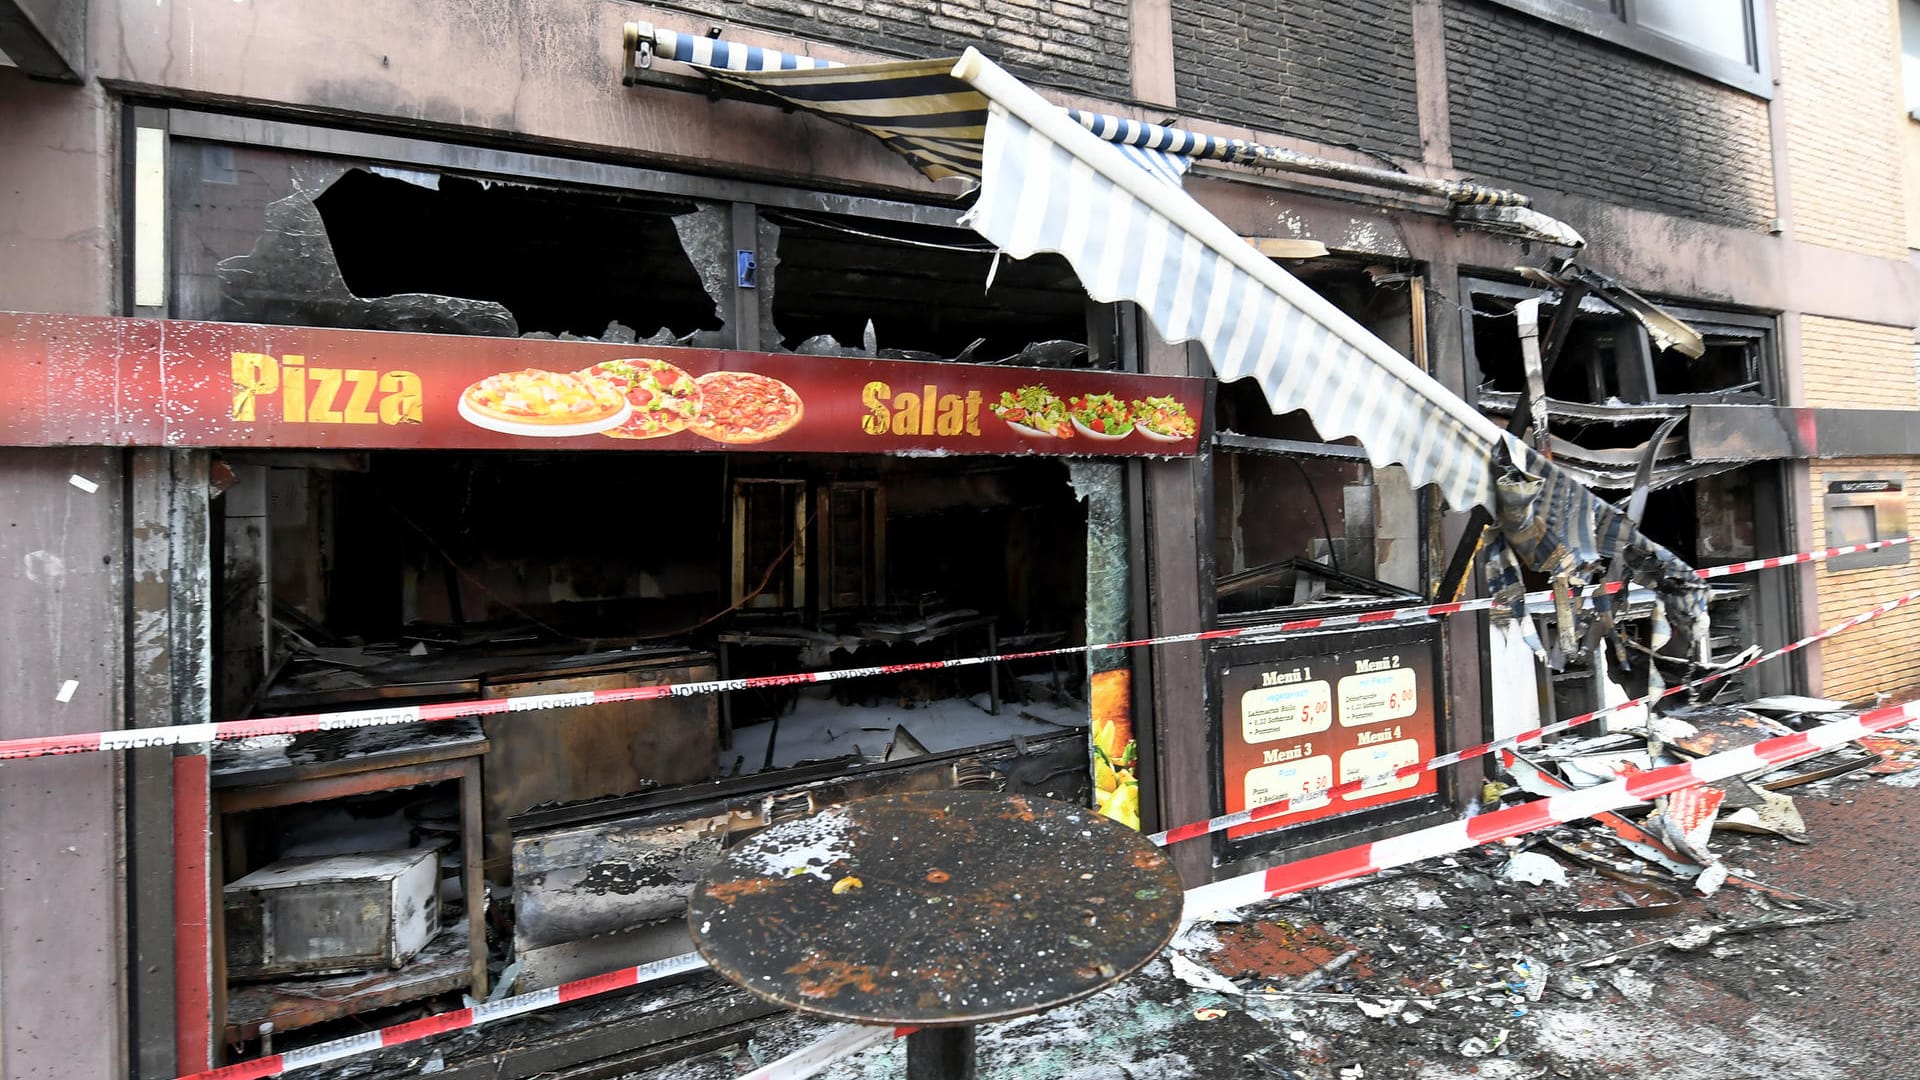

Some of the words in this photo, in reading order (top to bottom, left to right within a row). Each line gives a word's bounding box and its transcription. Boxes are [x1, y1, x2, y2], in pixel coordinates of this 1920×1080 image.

[231, 352, 423, 426] Pizza
[862, 381, 983, 437] Salat
[1355, 657, 1391, 673] Menü
[1391, 655, 1400, 668] 2
[1262, 669, 1302, 687] Menü
[1303, 668, 1312, 681] 1
[1357, 728, 1393, 746] Menü
[1393, 726, 1402, 739] 4
[1263, 745, 1302, 764] Menü
[1303, 742, 1312, 756] 3
